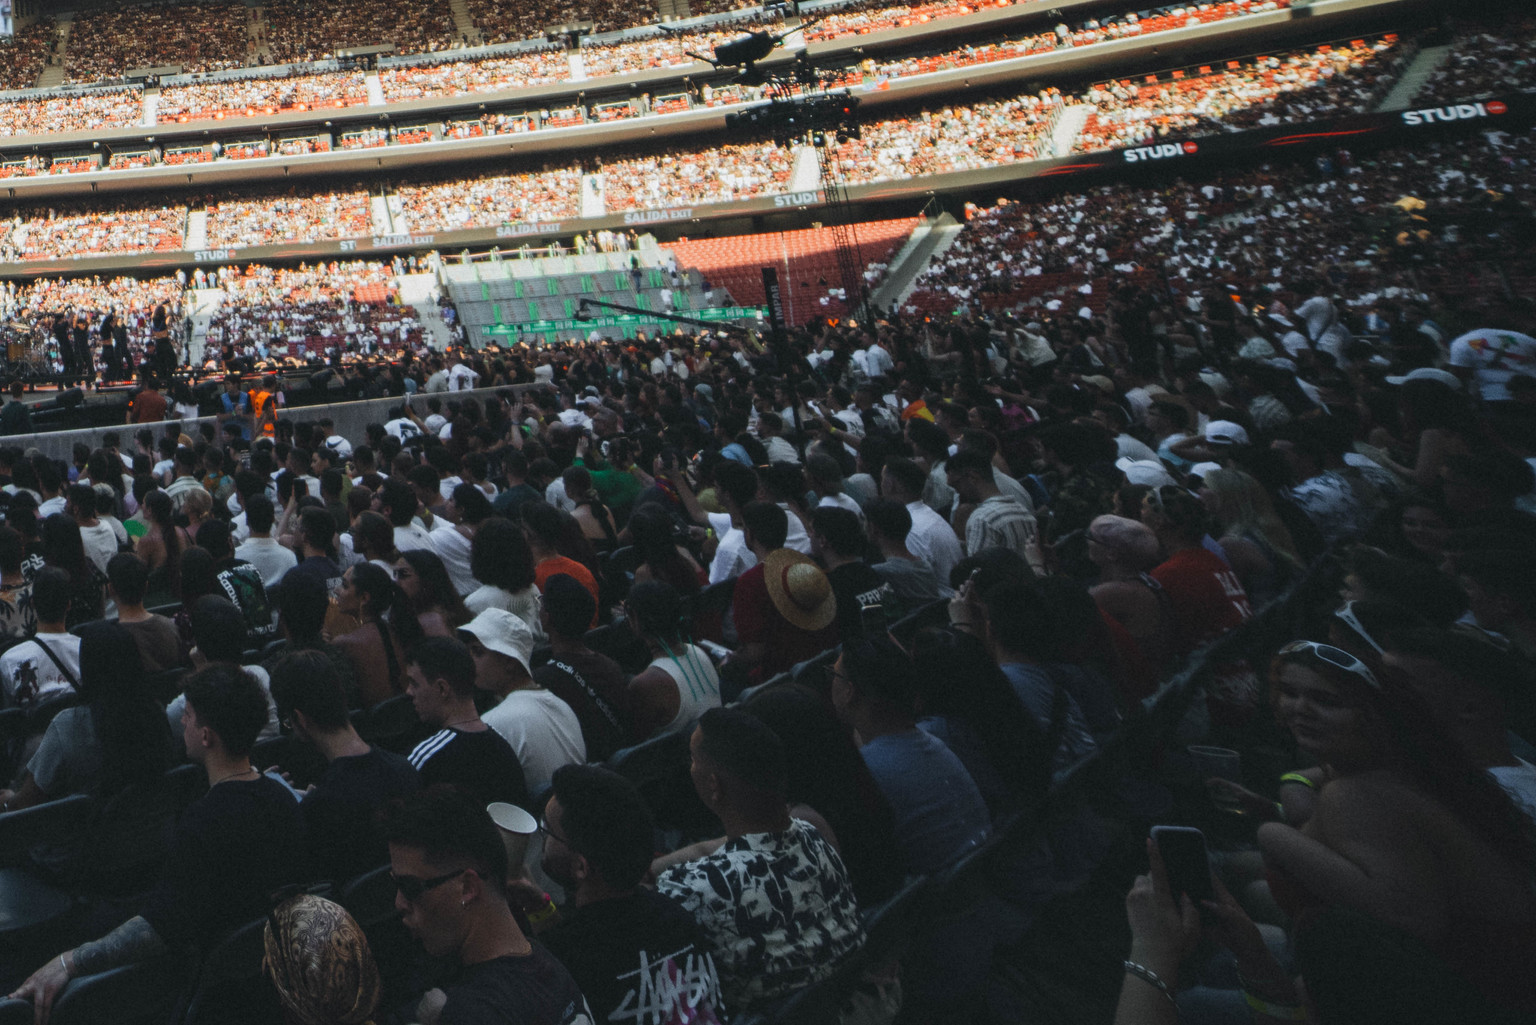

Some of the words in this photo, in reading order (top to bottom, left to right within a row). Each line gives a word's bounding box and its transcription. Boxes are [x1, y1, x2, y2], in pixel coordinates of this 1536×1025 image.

[624, 210, 669, 224] SALIDA
[670, 208, 693, 220] EXIT
[496, 223, 538, 237] SALIDA
[539, 222, 561, 233] EXIT
[372, 235, 413, 248] SALIDA
